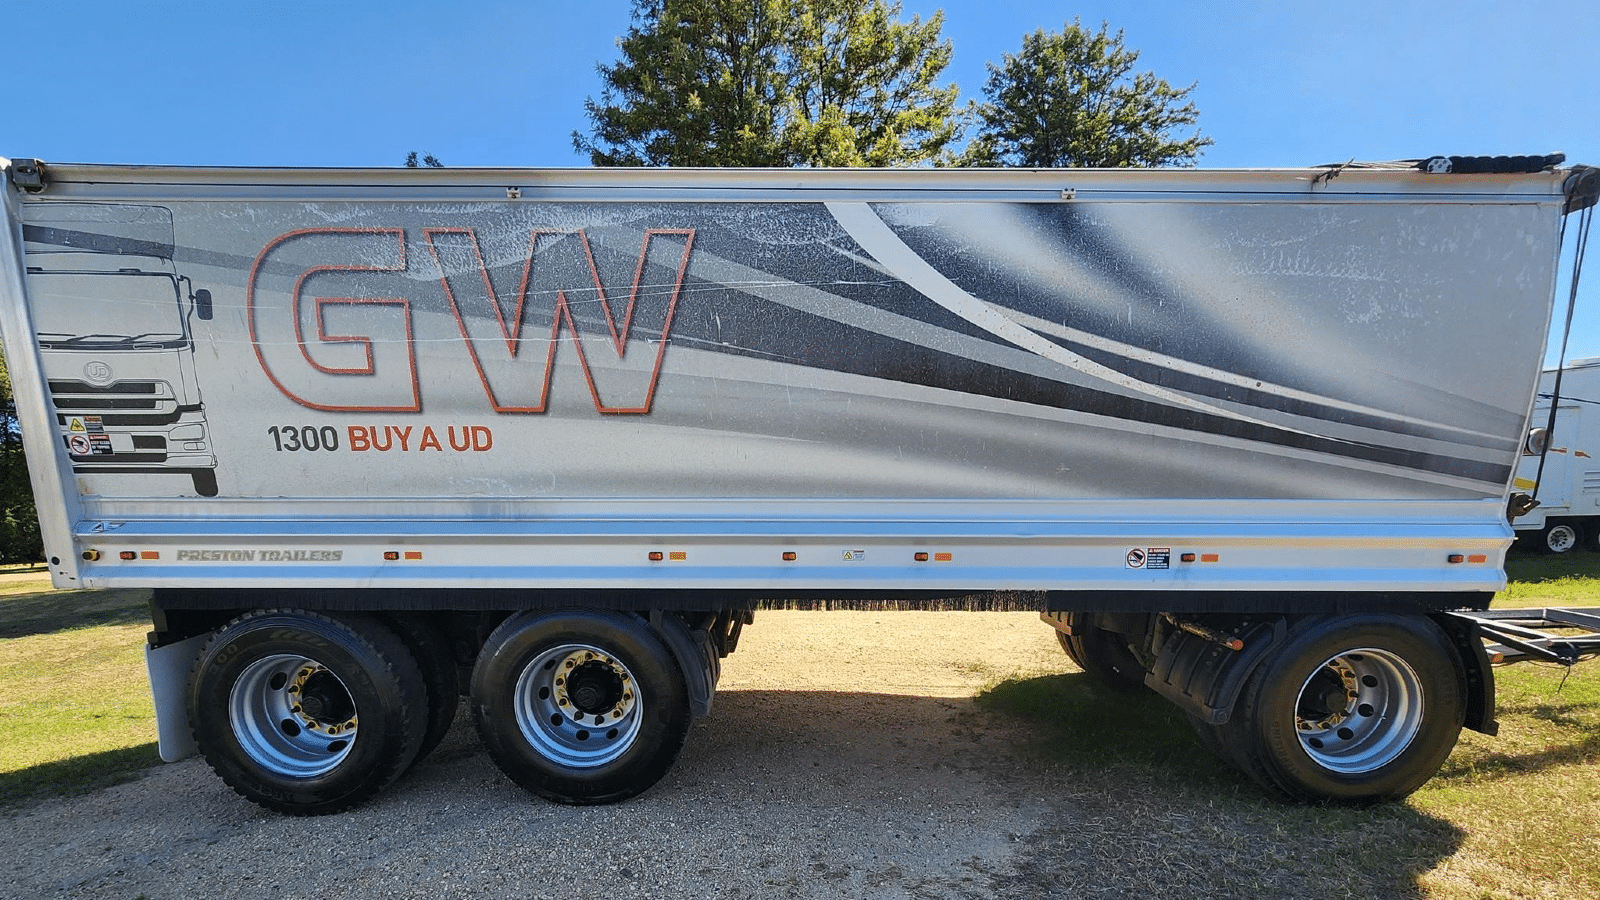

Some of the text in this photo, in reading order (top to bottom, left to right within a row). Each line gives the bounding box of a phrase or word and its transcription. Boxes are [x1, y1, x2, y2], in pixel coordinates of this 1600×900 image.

[246, 227, 696, 413] GW
[87, 365, 111, 378] UD
[267, 425, 493, 452] 1300 BUY A UD
[176, 549, 343, 562] PRESTON TRAILERS
